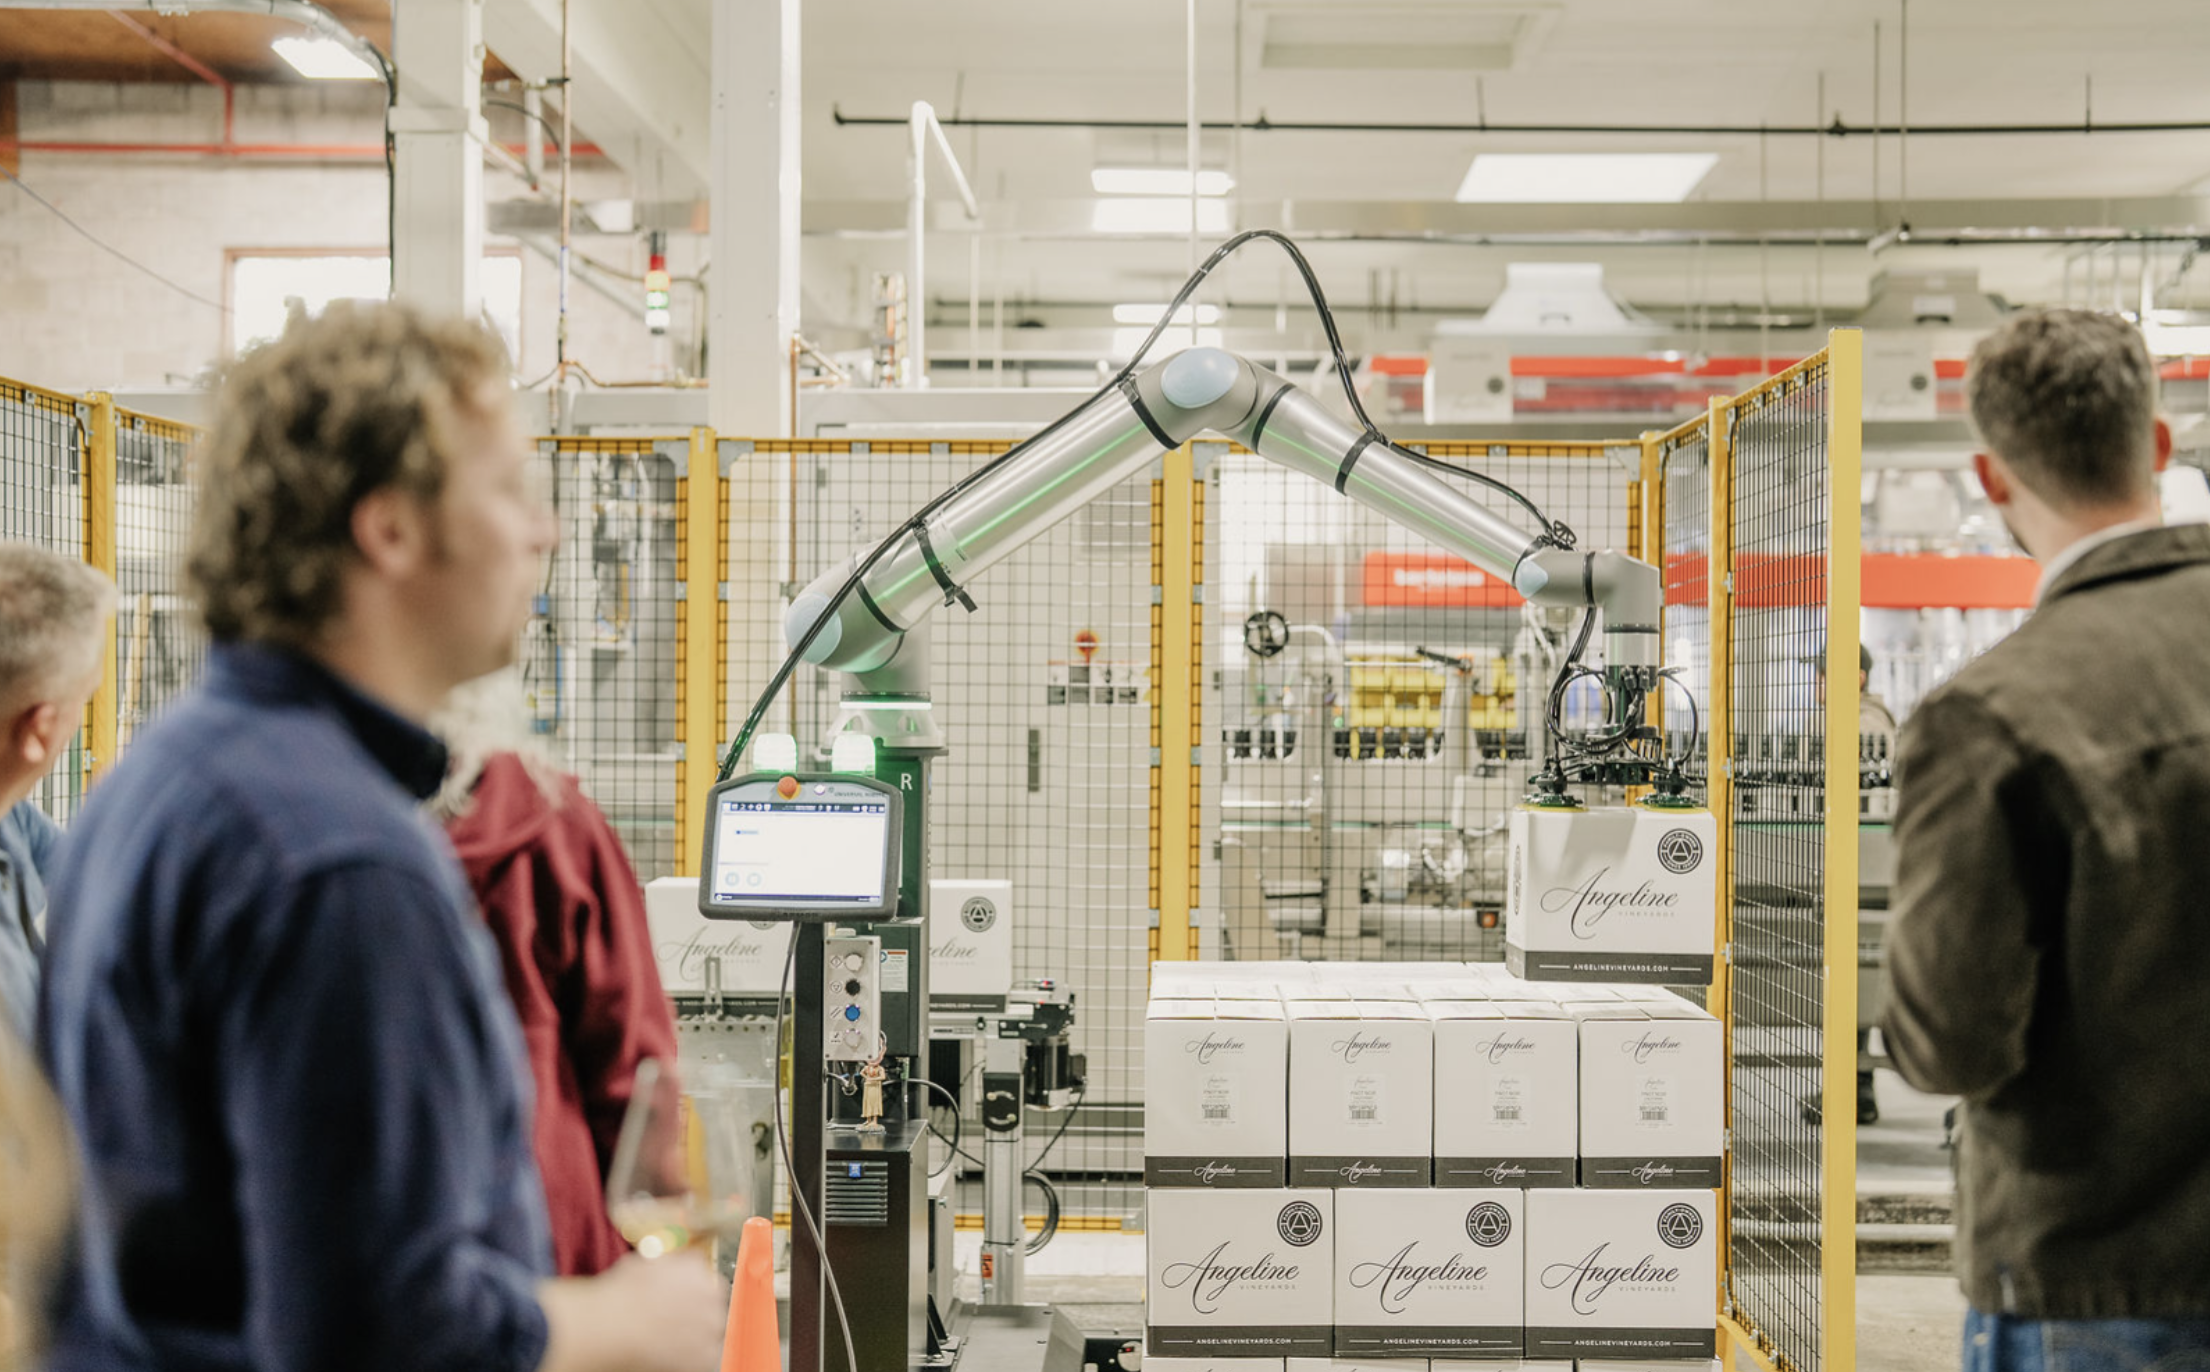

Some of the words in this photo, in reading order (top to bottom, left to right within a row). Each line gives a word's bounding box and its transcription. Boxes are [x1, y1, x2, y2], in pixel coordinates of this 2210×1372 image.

[1540, 866, 1680, 940] Angeline
[657, 925, 762, 982] Angeline
[1573, 963, 1669, 973] ANGELINEVINEYARDS.COM
[1184, 1031, 1245, 1065] Angeline
[1331, 1031, 1392, 1064] Angeline
[1475, 1032, 1536, 1065] Angeline
[1621, 1031, 1682, 1065] Angeline
[1193, 1161, 1237, 1184] Angeline
[1339, 1161, 1383, 1184] Angeline
[1483, 1162, 1527, 1185] Angeline
[1631, 1161, 1675, 1185] Angeline
[1162, 1241, 1300, 1315] Angeline
[1239, 1283, 1297, 1291] VINEYARDS
[1349, 1241, 1488, 1315] Angeline
[1540, 1242, 1680, 1316] Angeline
[1618, 1285, 1677, 1293] VINEYARDS
[1196, 1337, 1292, 1345] ANGELINEVINEYARDS.COM
[1383, 1338, 1480, 1346] ANGELINEVINEYARDS.COM
[1574, 1339, 1671, 1347] ANGELINEVINEYARDS.COM
